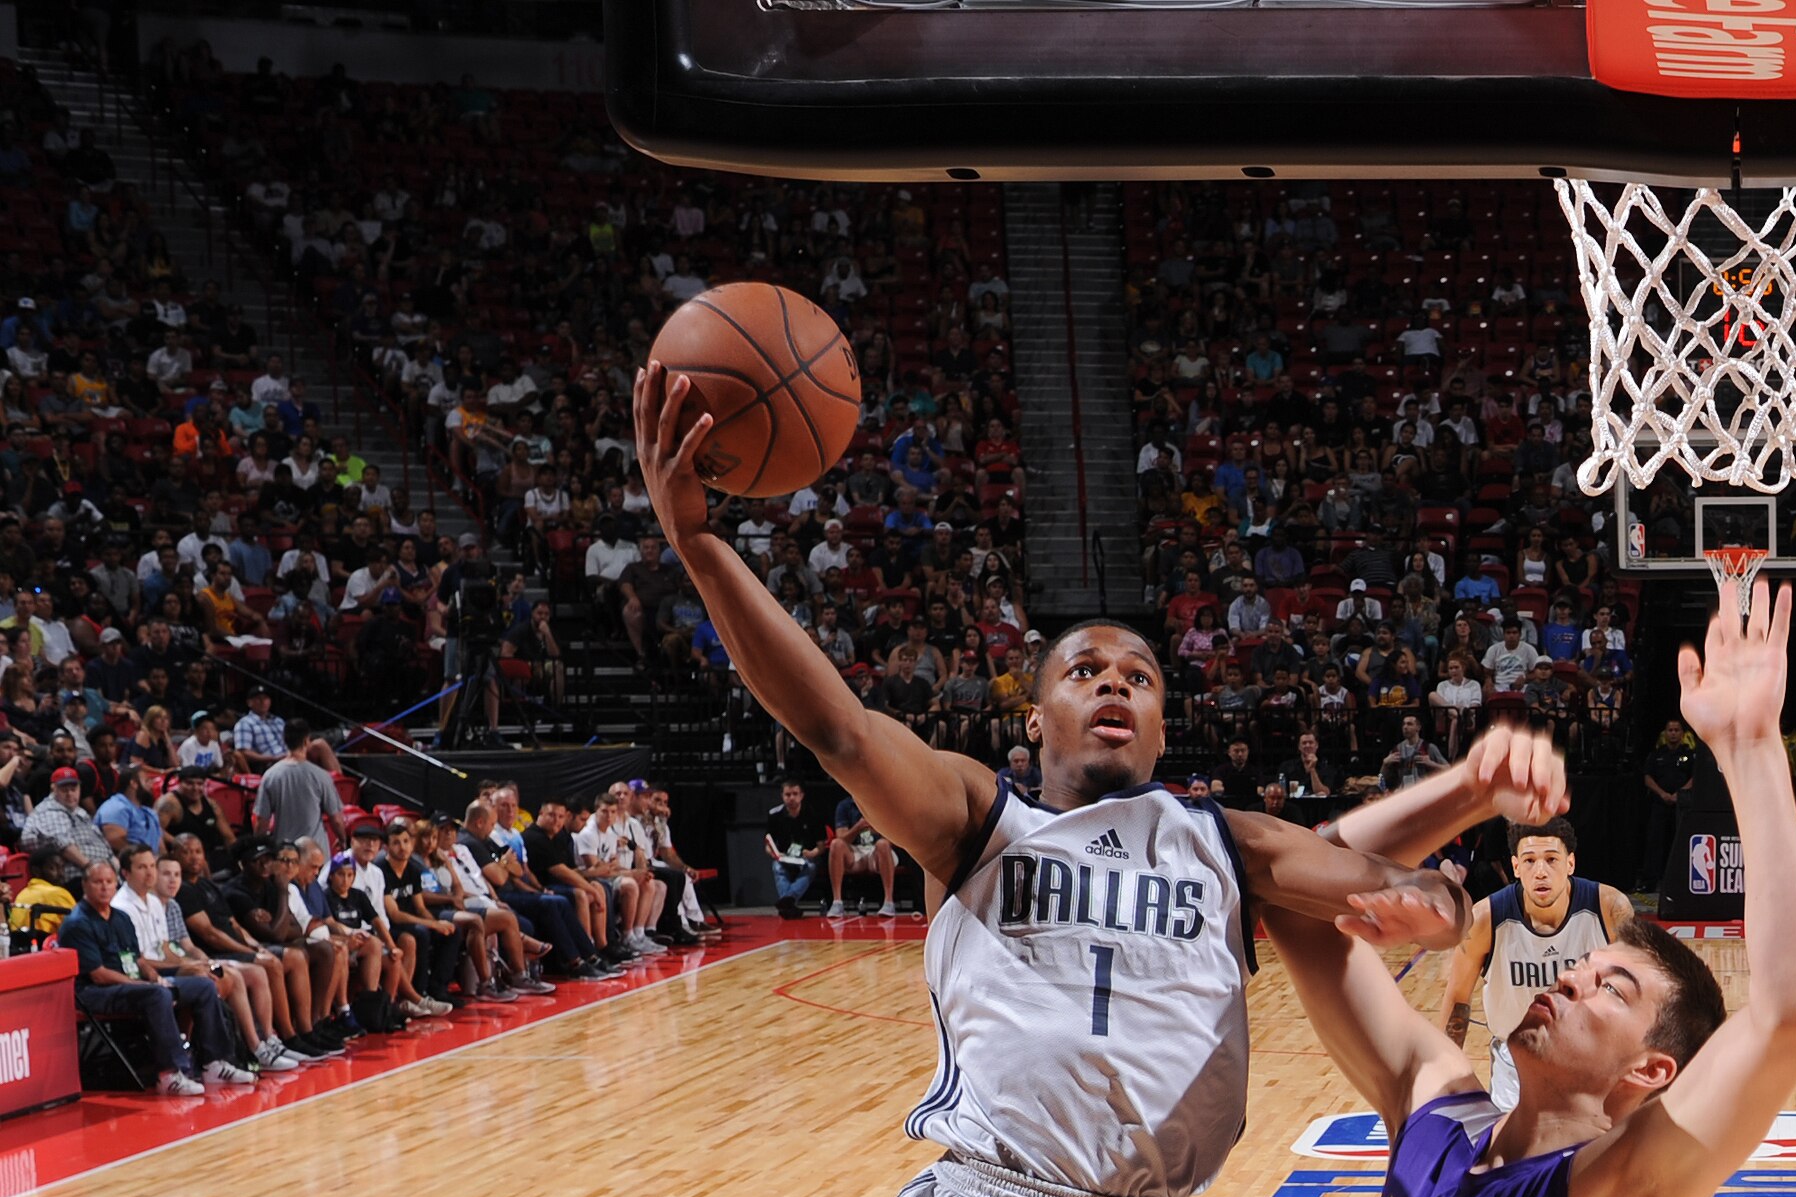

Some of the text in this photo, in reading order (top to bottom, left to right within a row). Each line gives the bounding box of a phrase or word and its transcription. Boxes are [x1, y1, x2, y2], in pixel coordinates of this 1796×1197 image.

[1000, 852, 1206, 942] DALLAS
[1085, 844, 1129, 860] adidas
[1089, 945, 1114, 1037] 1
